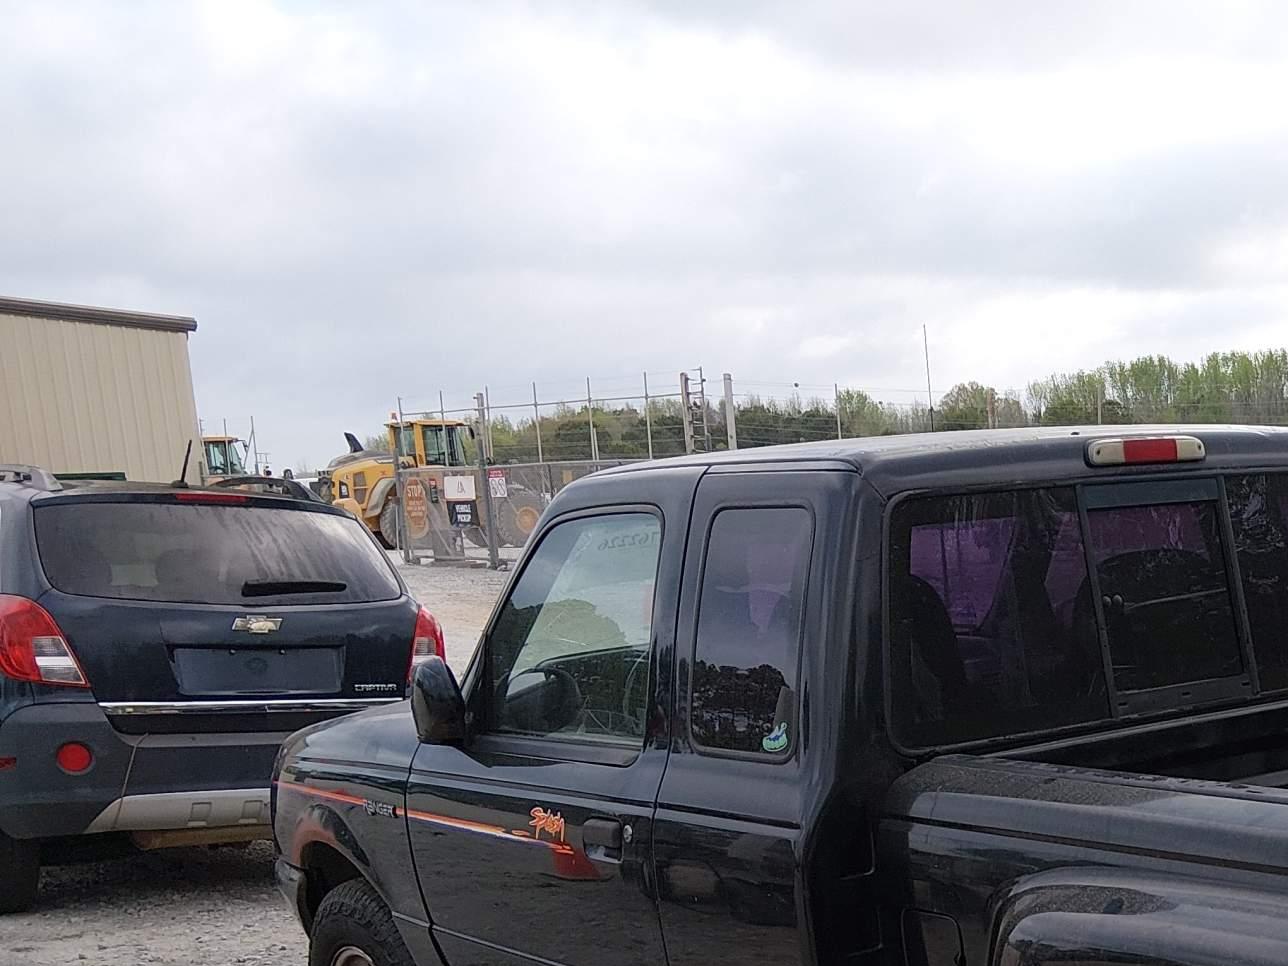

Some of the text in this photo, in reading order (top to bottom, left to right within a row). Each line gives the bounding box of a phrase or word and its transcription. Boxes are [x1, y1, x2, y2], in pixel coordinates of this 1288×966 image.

[407, 485, 424, 497] STOP
[354, 683, 397, 692] CAPTIVA
[363, 799, 394, 818] RANGER
